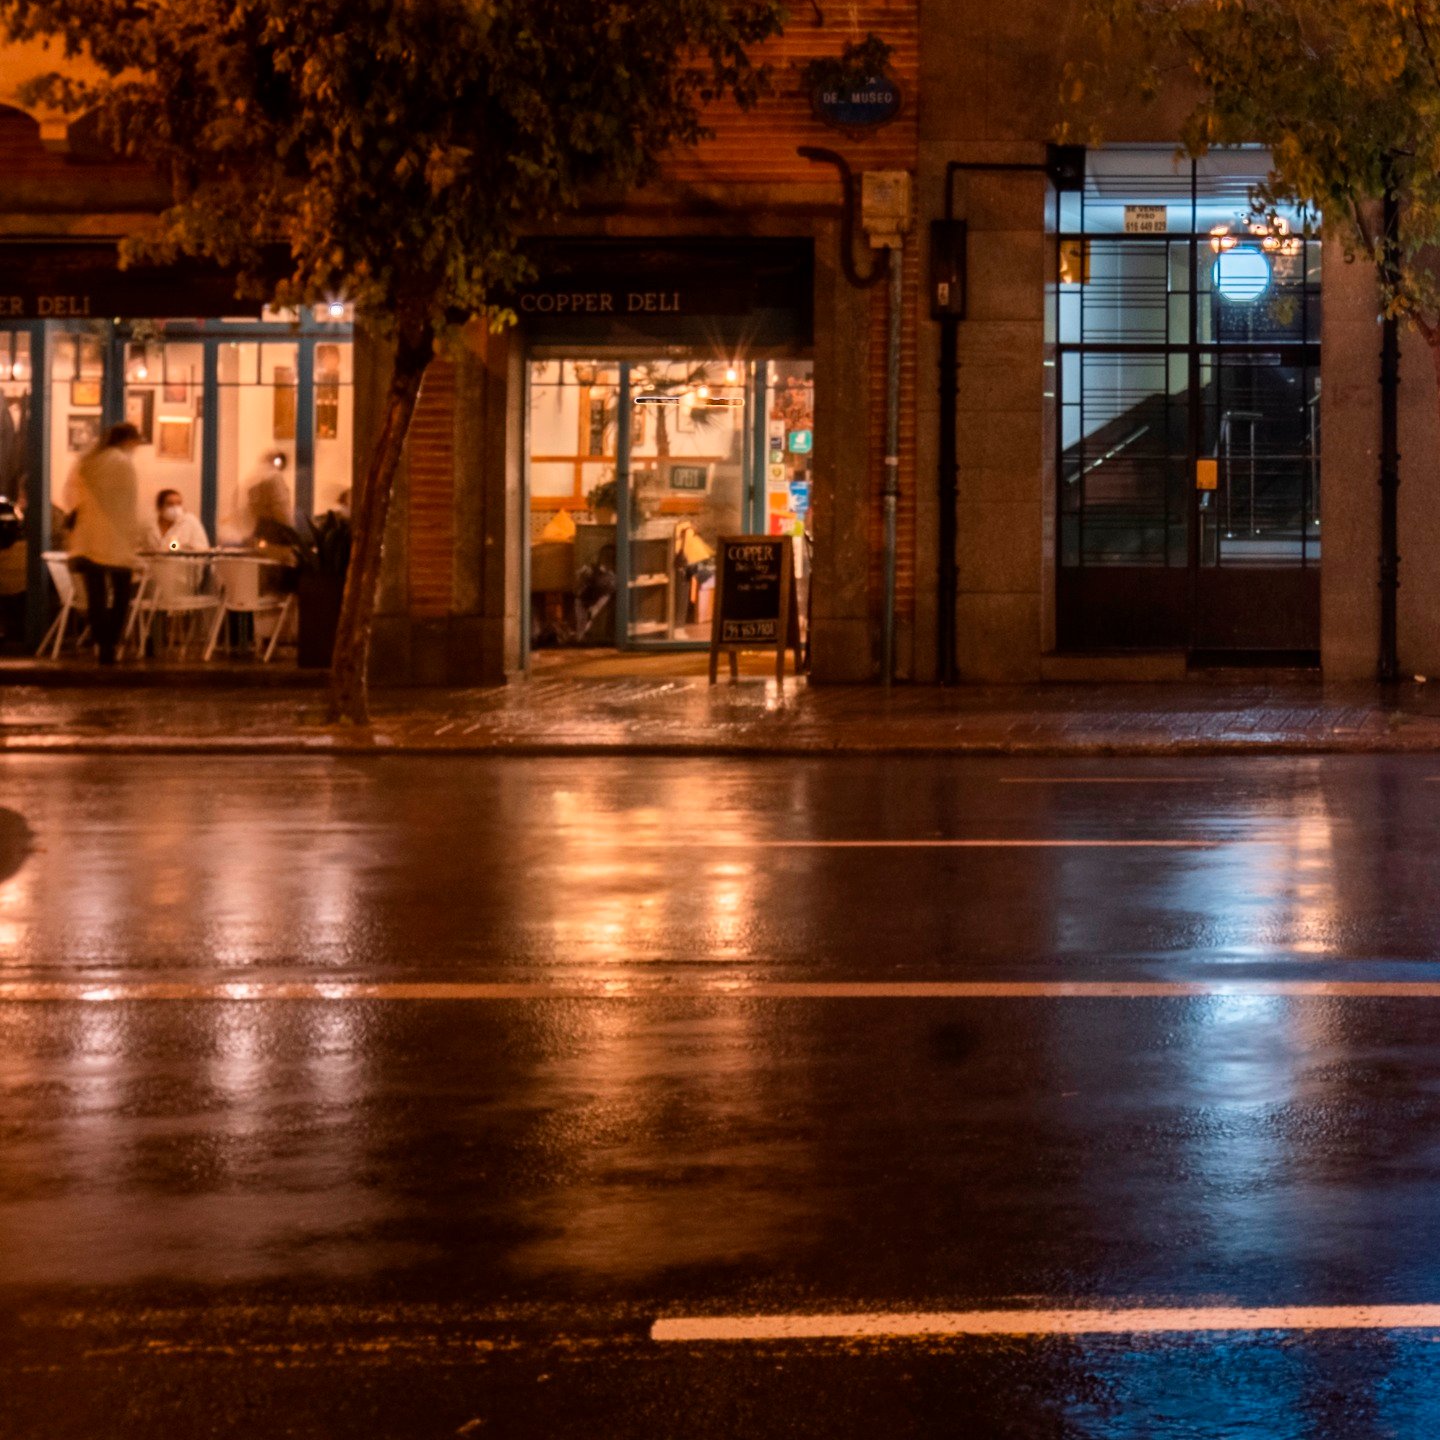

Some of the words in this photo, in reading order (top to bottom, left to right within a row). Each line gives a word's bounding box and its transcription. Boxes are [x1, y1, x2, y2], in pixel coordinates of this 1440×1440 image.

[823, 92, 846, 104] DE
[851, 92, 893, 104] MUSEO
[37, 296, 90, 315] DELI
[520, 293, 613, 311] COPPER
[627, 292, 680, 311] DELI
[728, 545, 774, 561] COPPER
